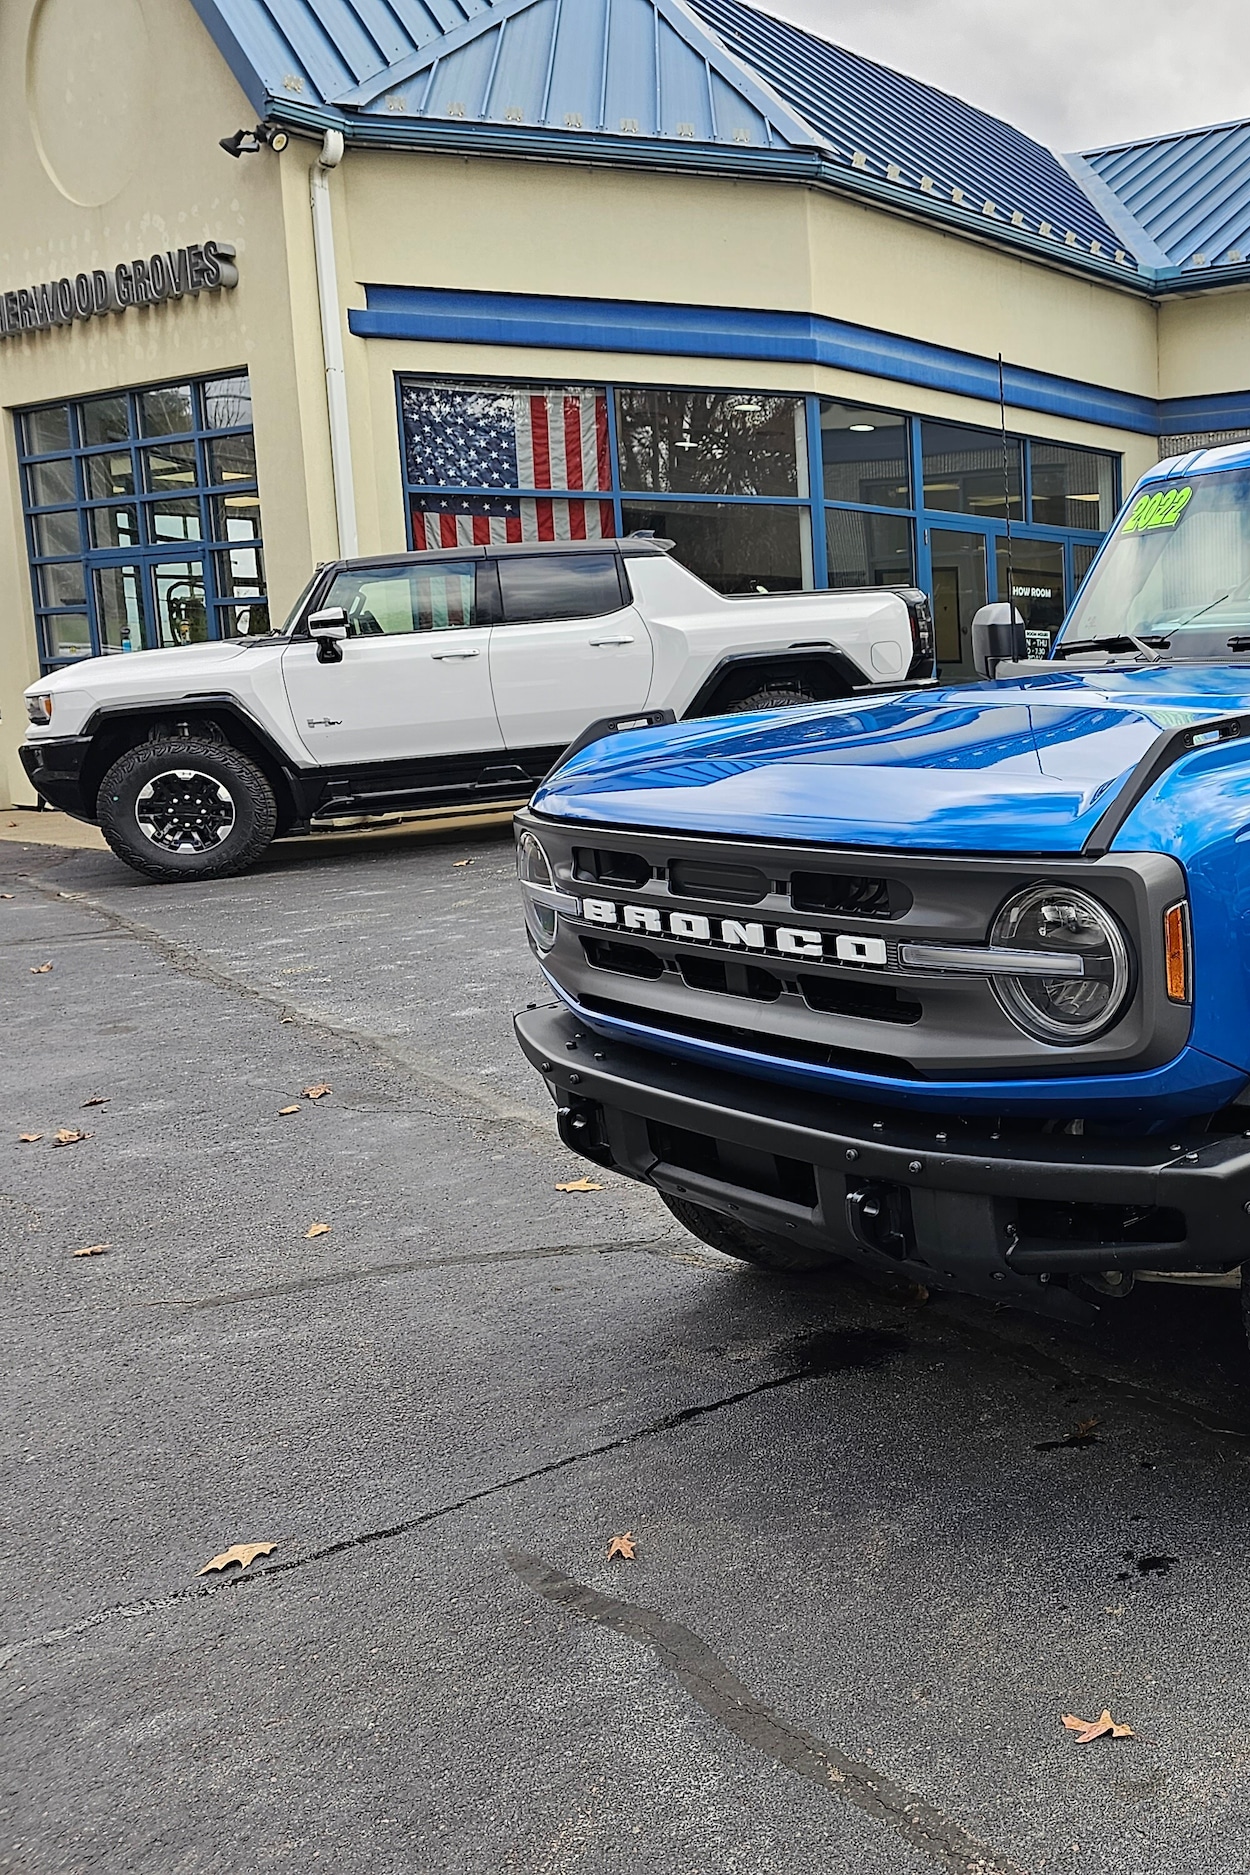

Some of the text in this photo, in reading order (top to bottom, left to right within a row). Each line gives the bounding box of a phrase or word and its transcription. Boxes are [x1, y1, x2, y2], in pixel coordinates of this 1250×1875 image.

[115, 240, 228, 309] GROVES
[1121, 487, 1193, 534] 2022
[1012, 586, 1051, 598] HOW ROOM
[583, 898, 888, 965] BRONCO
